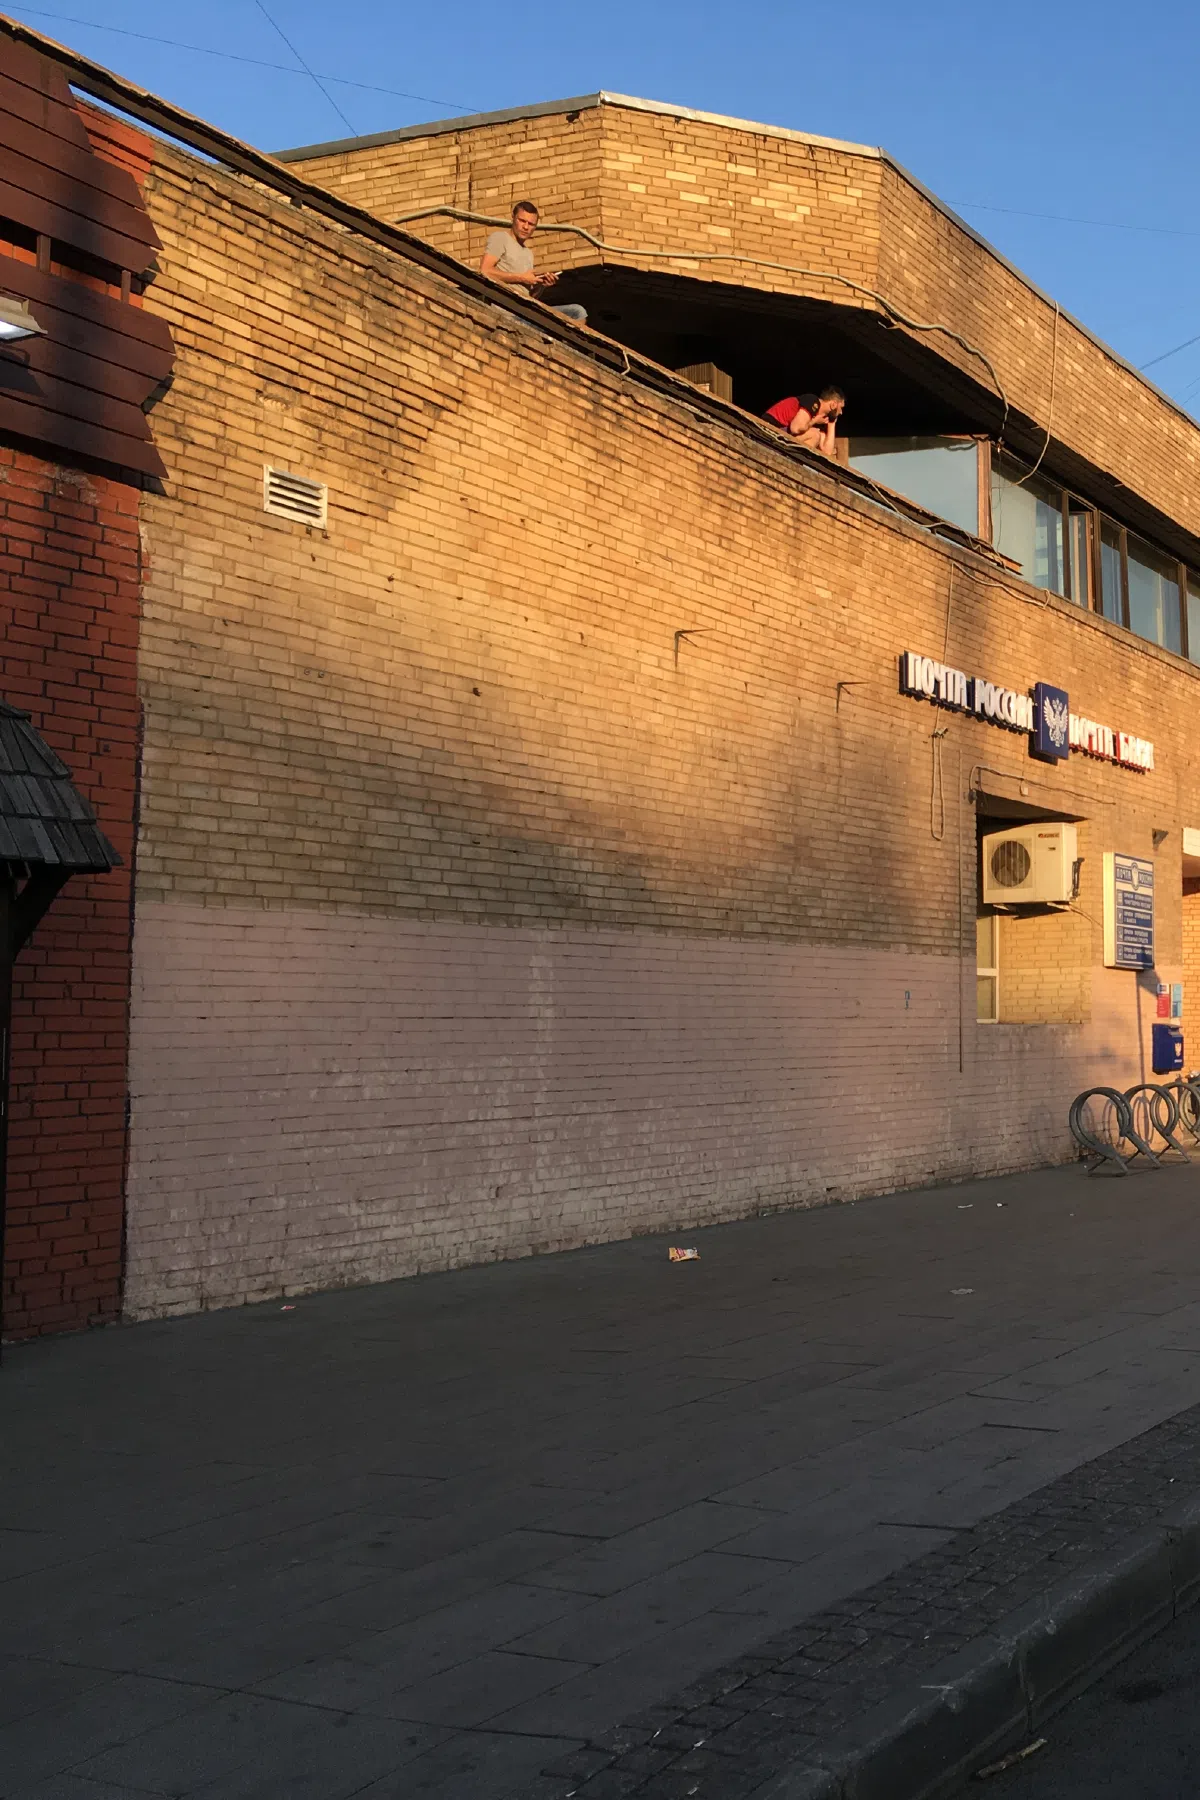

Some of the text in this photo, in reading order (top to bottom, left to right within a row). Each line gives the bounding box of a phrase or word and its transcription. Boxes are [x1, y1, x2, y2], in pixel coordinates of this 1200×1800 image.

[904, 651, 1034, 731] ПОЧТА РОССИИ
[1068, 713, 1114, 758] ПОЧТА
[1116, 867, 1132, 881] ПОЧТА
